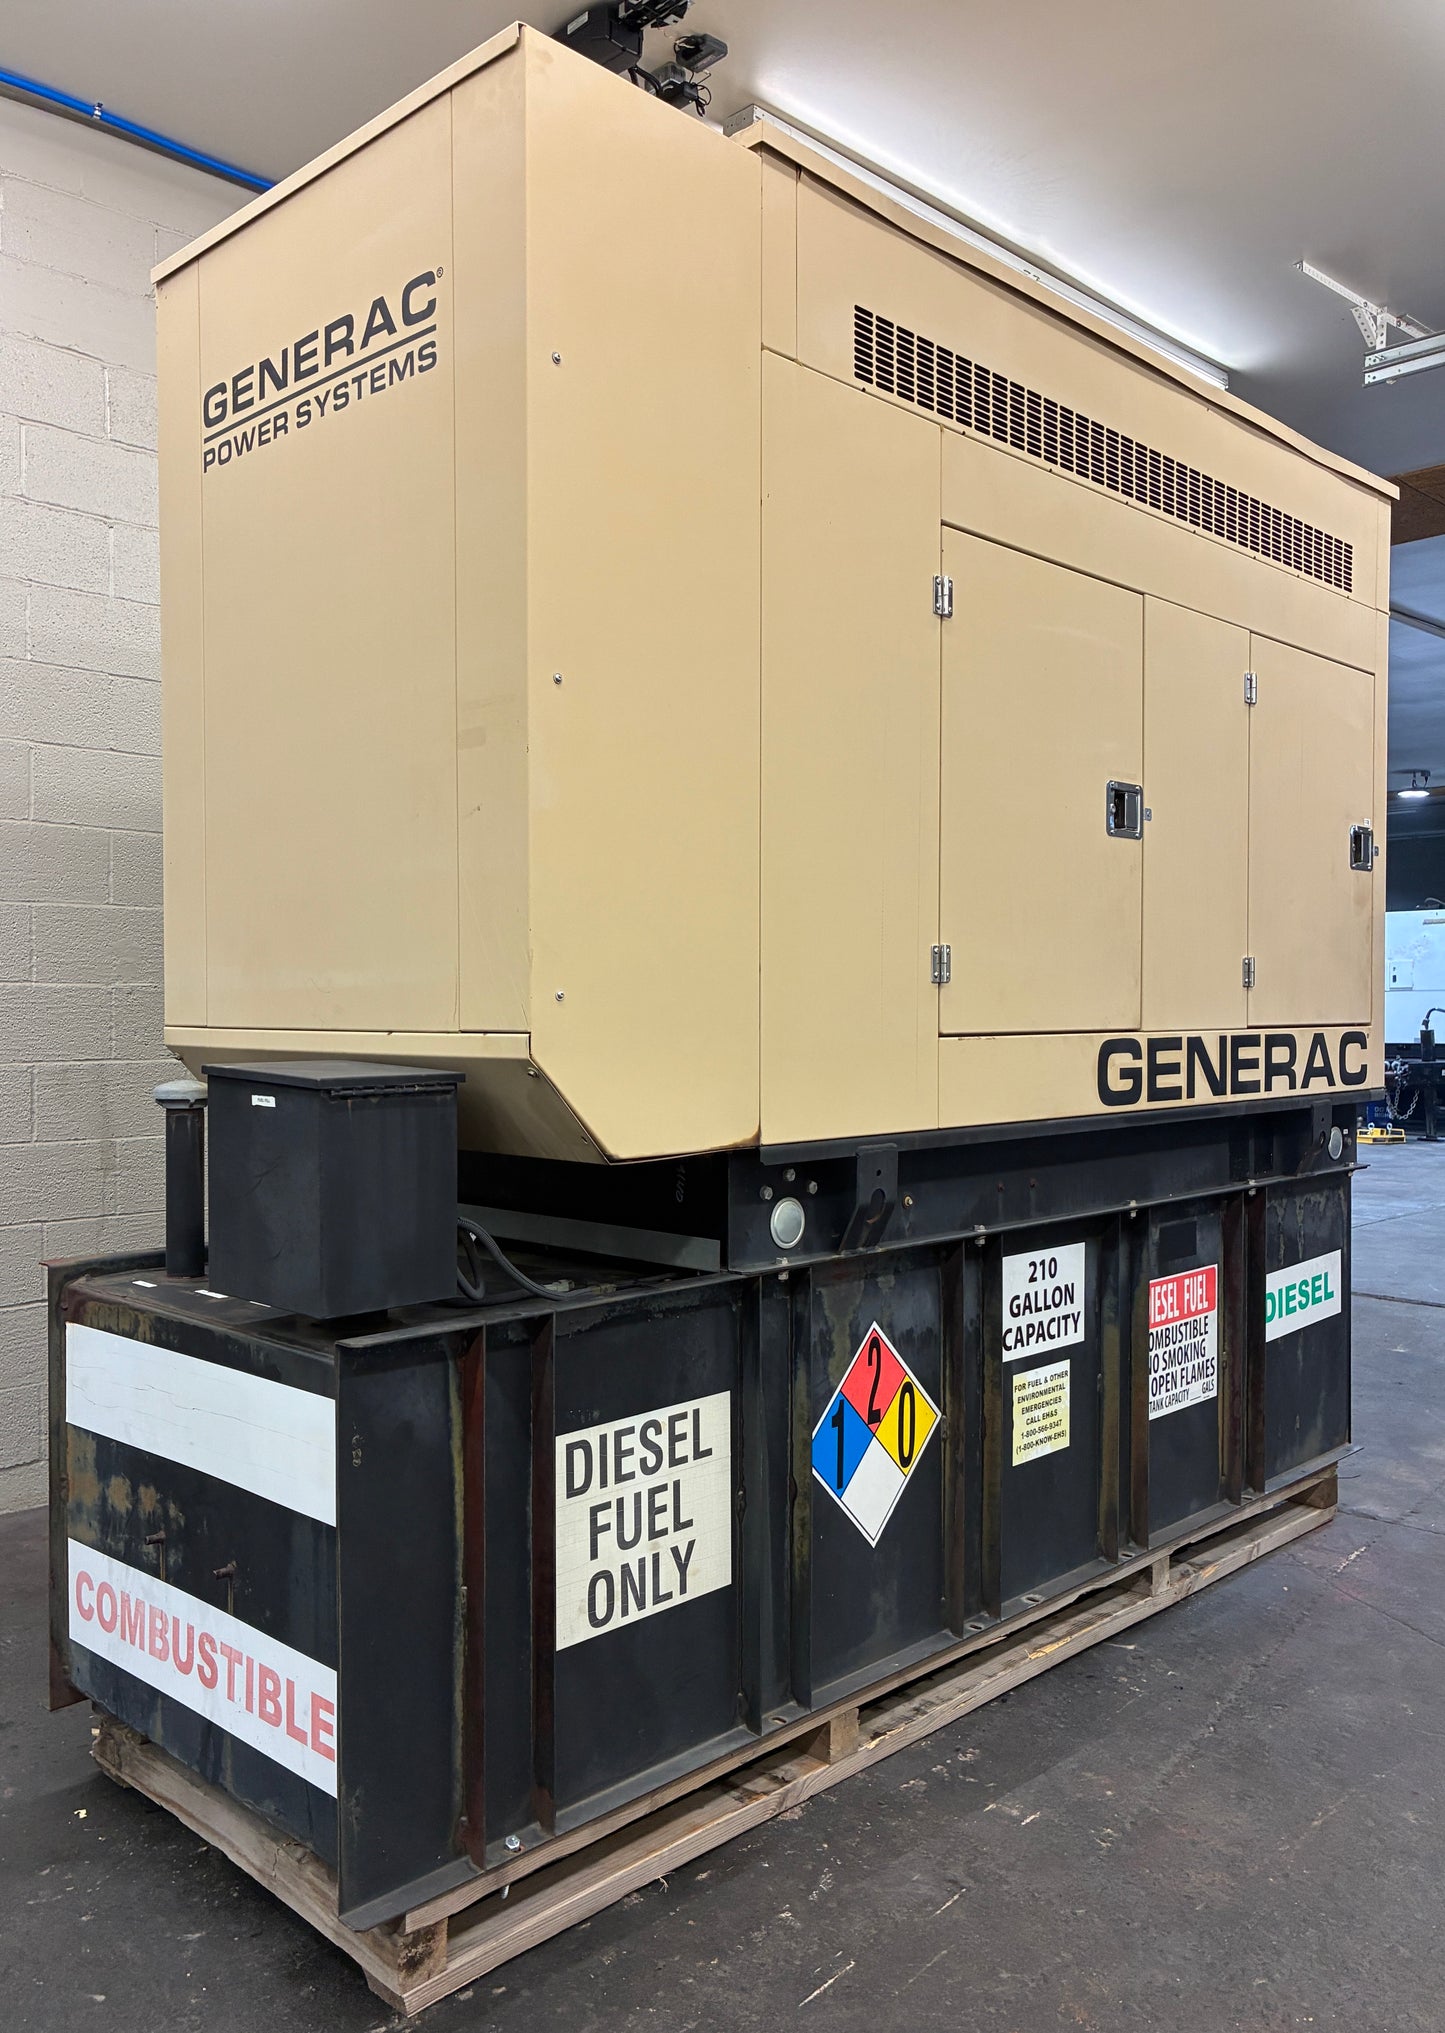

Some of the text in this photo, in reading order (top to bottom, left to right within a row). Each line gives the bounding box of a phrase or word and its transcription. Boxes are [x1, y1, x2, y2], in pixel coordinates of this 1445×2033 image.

[203, 340, 437, 474] POWER SYSTEMS
[1098, 1031, 1368, 1107] GENERAC
[1028, 1256, 1058, 1283] 210
[1009, 1282, 1075, 1318] GALLON
[1150, 1273, 1208, 1324] IESEL FUEL
[1265, 1271, 1334, 1324] DIESEL
[1002, 1311, 1081, 1352] CAPACITY
[1149, 1315, 1209, 1353] OMBUSTIBLE
[1162, 1338, 1206, 1372] SMOKING
[867, 1336, 881, 1425] 2
[1014, 1382, 1027, 1393] FOR
[1027, 1378, 1043, 1390] FUEL
[1049, 1370, 1069, 1382] OTHER
[1017, 1383, 1066, 1404] ENVIRONMENTAL
[1149, 1378, 1214, 1414] TANK CAPACITY GALS
[1151, 1357, 1215, 1398] OPEN FLAMES
[1021, 1395, 1062, 1415] EMERGENCIES
[1025, 1408, 1058, 1426] CALL EH&S
[565, 1407, 713, 1500] DIESEL
[831, 1381, 916, 1490] 1 0
[589, 1479, 694, 1561] FUEL
[587, 1539, 696, 1629] ONLY
[75, 1570, 336, 1763] COMBUSTIBLE
